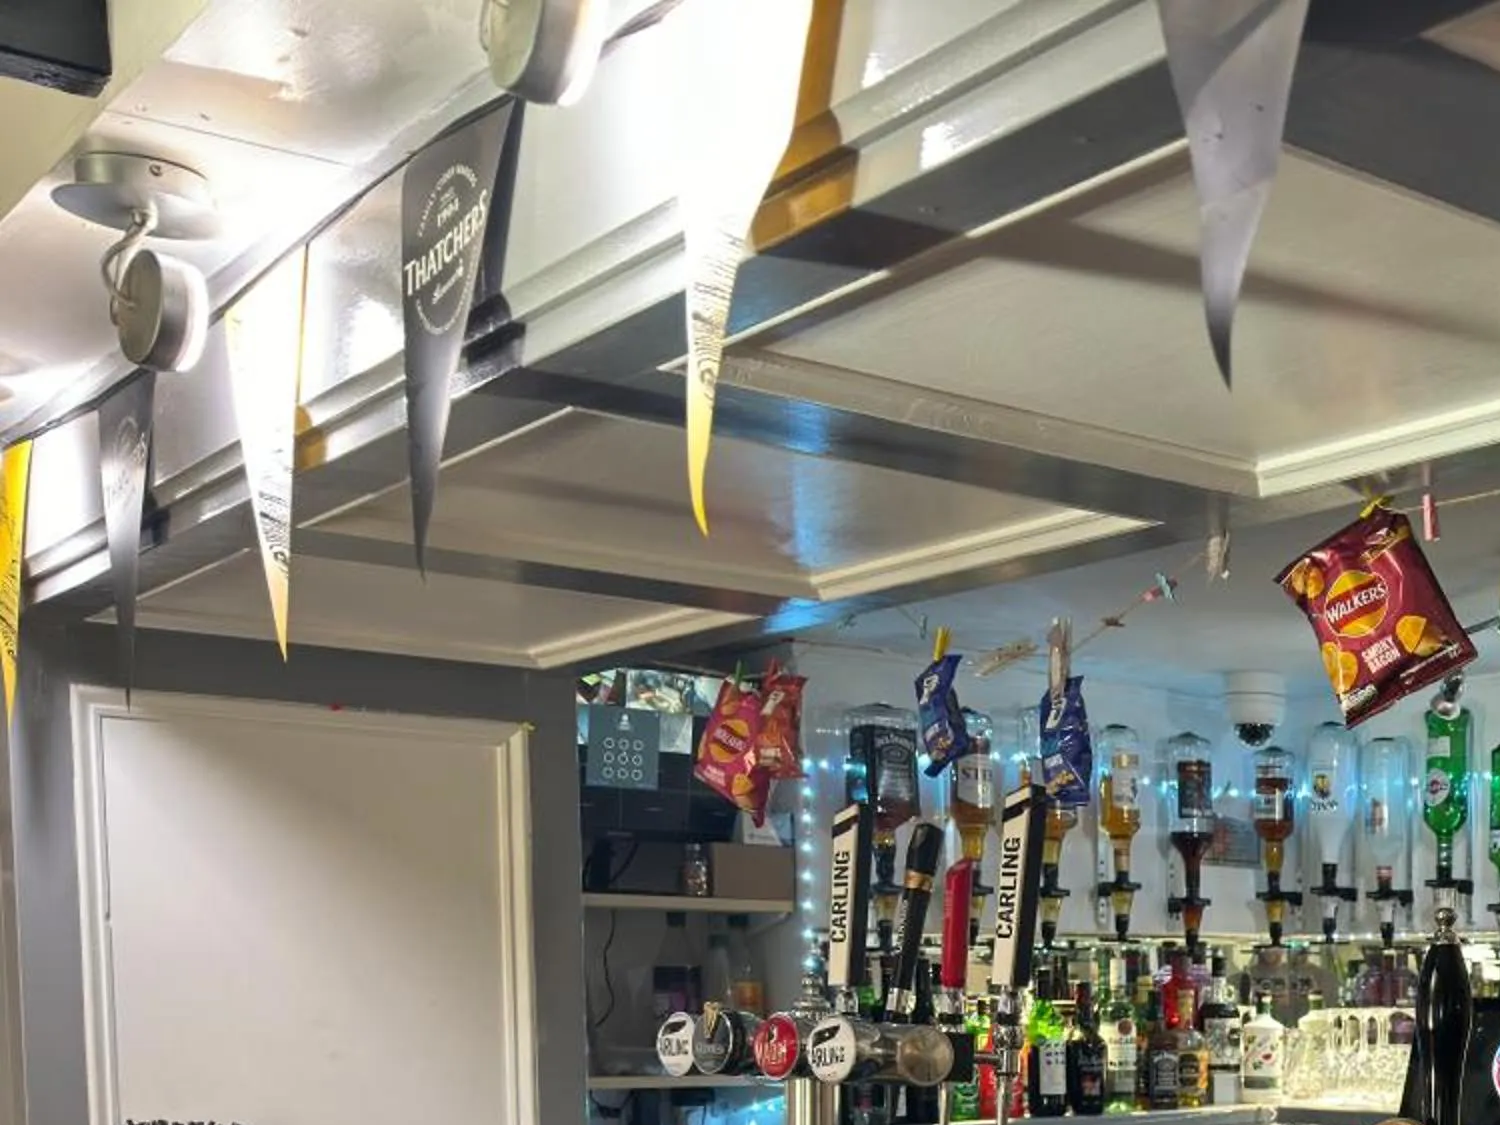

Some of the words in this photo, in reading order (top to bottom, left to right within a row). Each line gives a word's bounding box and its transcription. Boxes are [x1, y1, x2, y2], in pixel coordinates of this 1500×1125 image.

[404, 188, 488, 297] THATCHERS
[1325, 582, 1388, 624] WALKERS
[831, 850, 849, 943] CARLING
[997, 837, 1021, 939] CARLING
